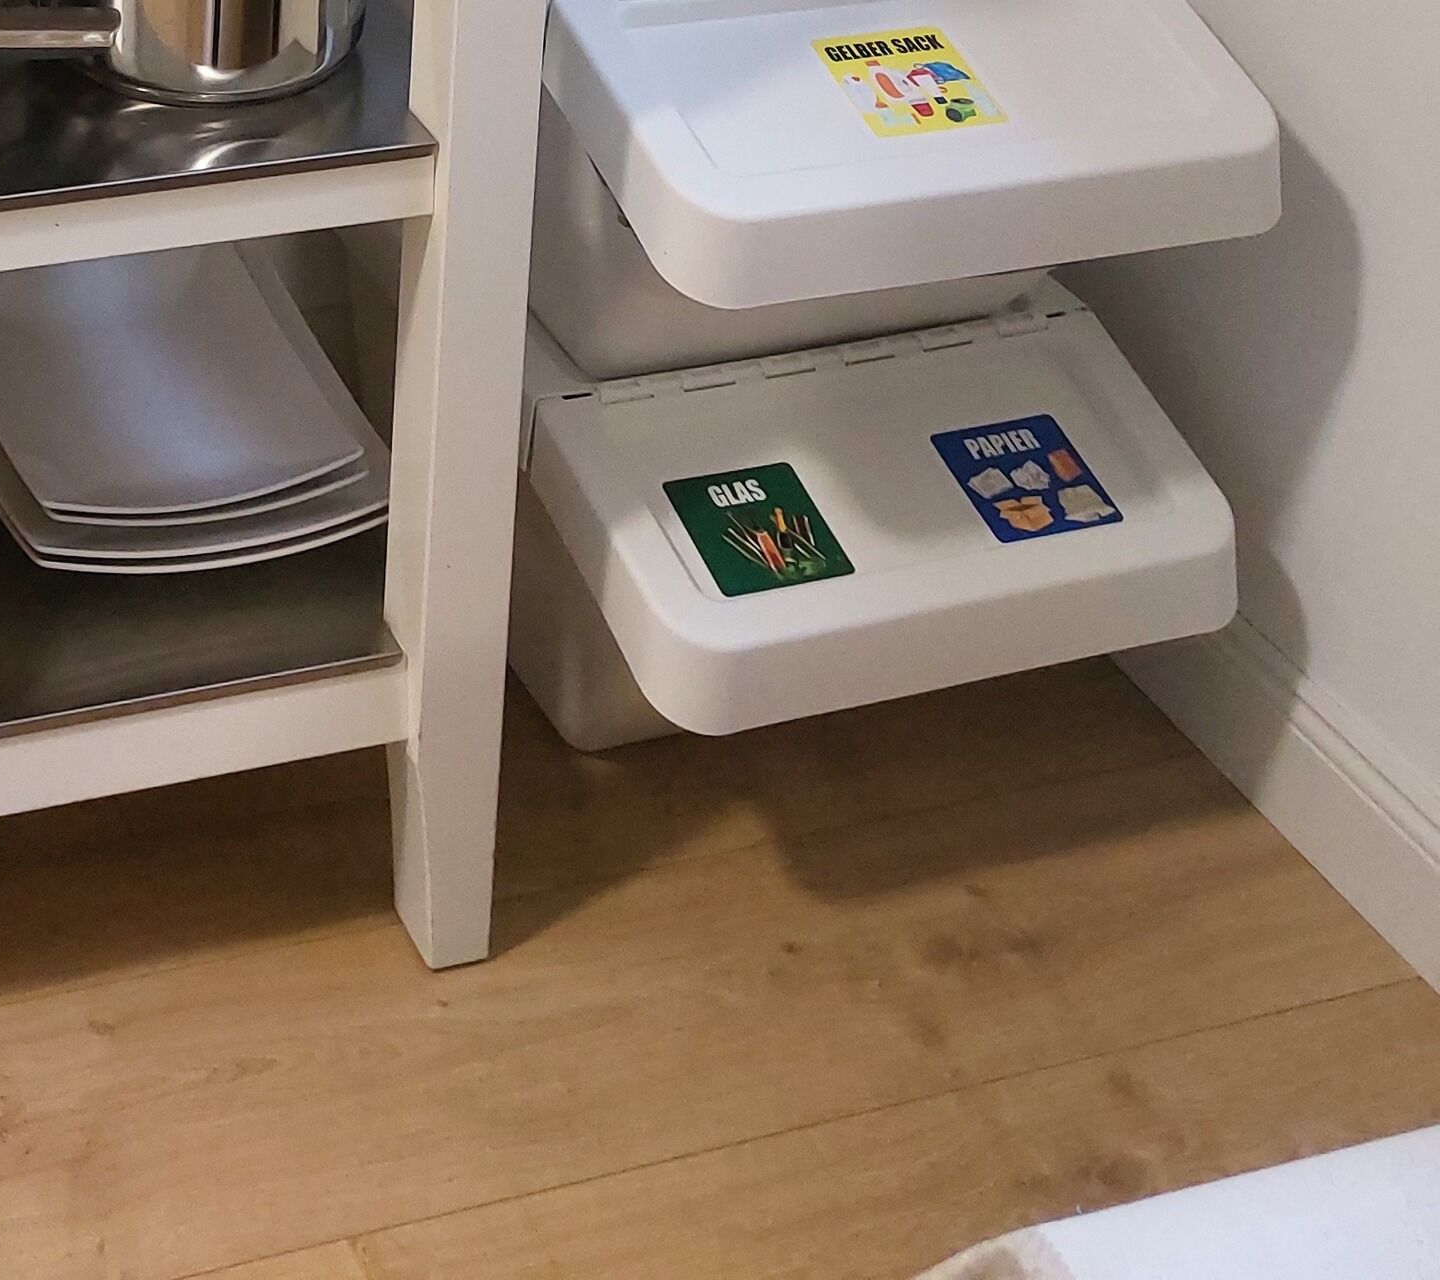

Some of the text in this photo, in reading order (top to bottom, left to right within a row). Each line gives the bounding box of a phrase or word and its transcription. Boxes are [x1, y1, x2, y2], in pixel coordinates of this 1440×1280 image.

[824, 34, 945, 62] GELBER SACK
[963, 428, 1041, 460] PAPIER
[707, 479, 767, 507] GLAS
